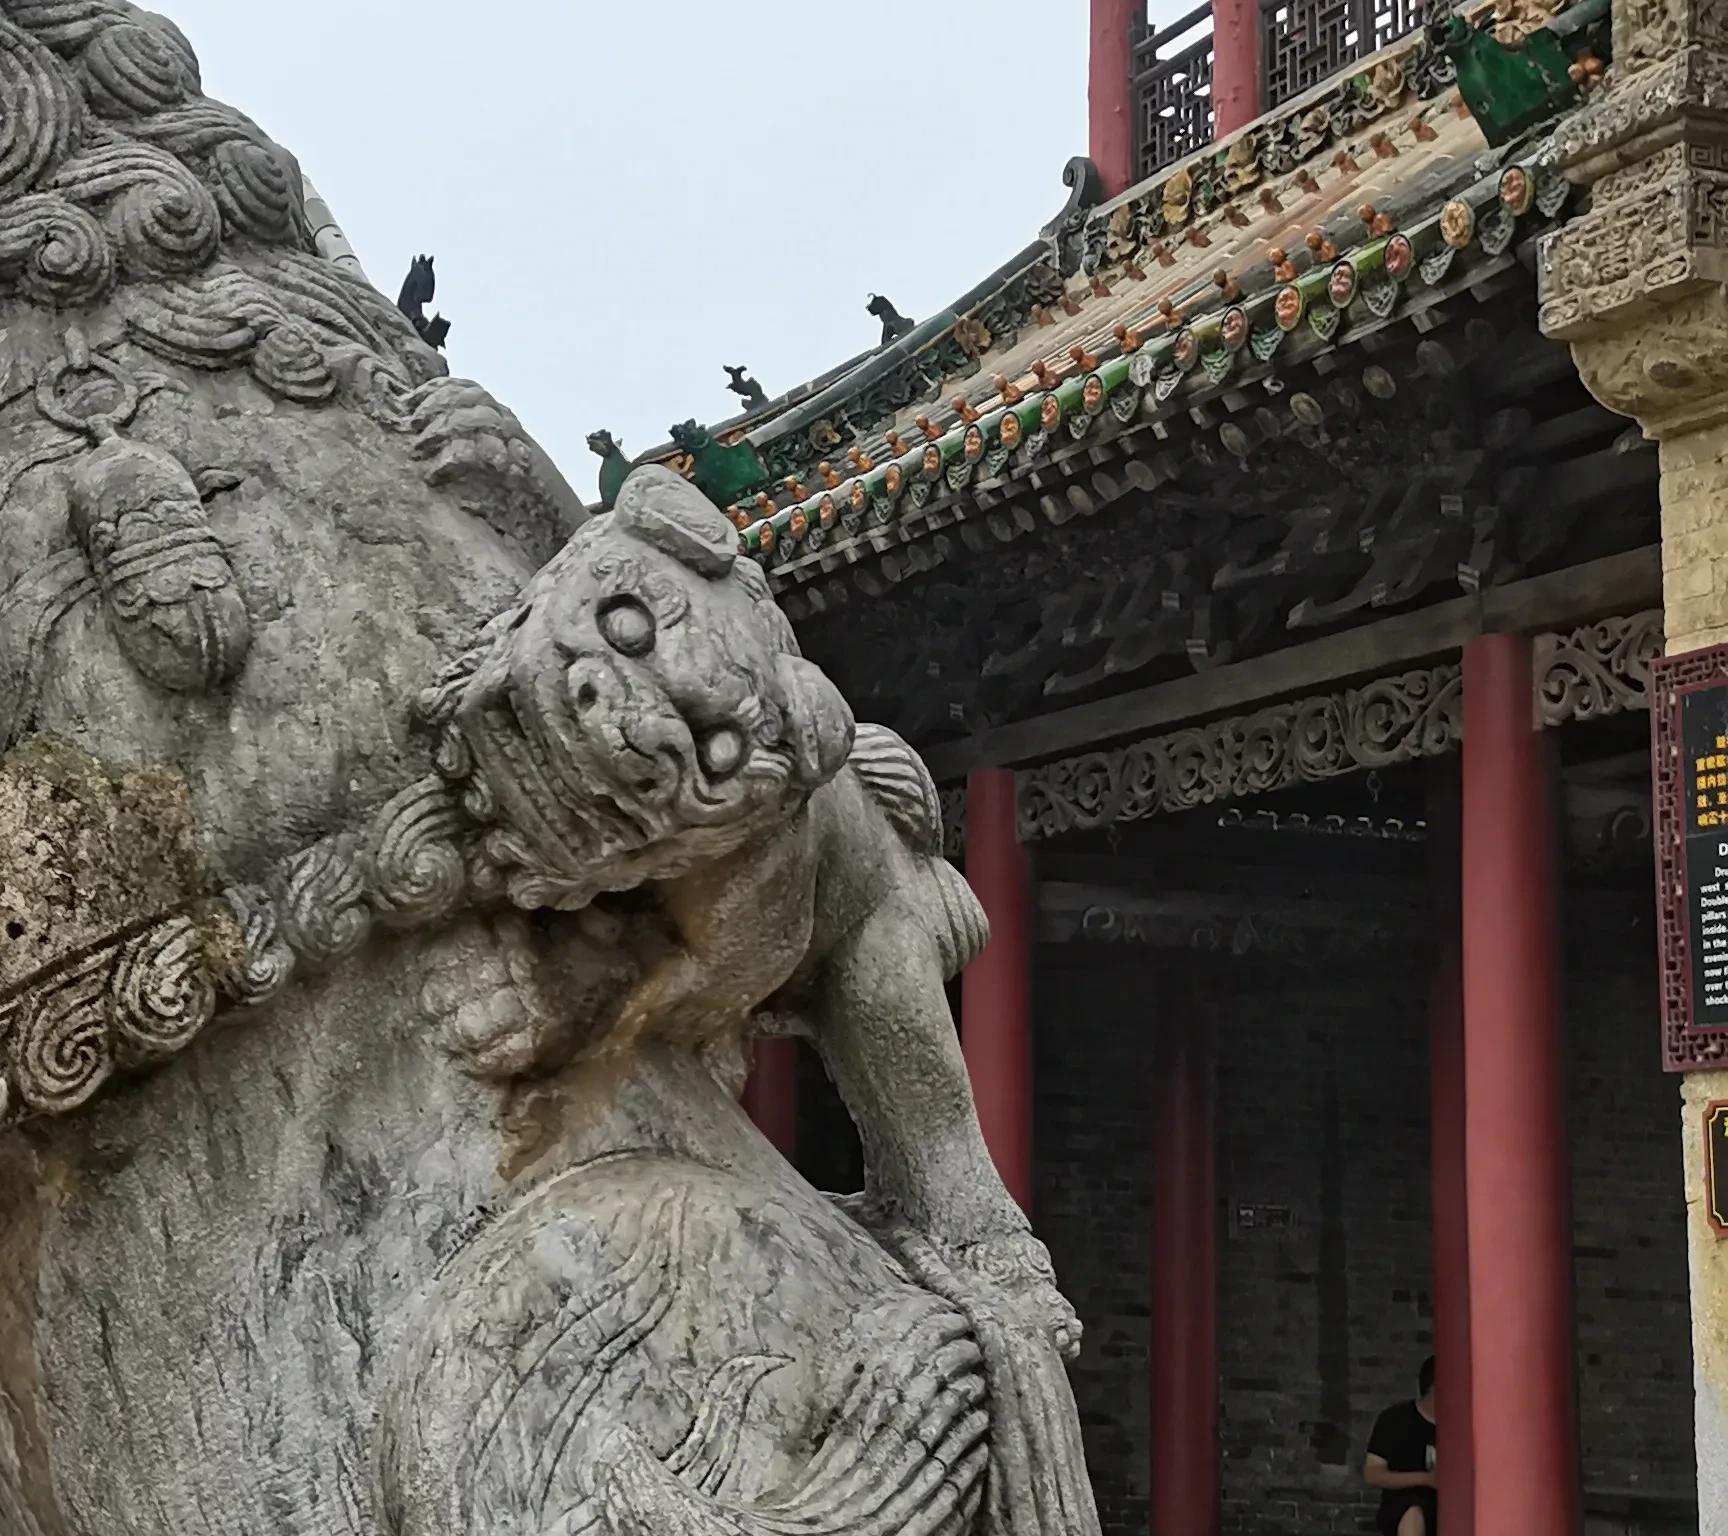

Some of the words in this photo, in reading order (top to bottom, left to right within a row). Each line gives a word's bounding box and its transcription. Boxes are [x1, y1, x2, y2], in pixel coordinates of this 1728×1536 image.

[1700, 882, 1720, 893] west
[1701, 910, 1727, 924] pillars
[1702, 939, 1712, 949] in
[1713, 938, 1727, 949] the
